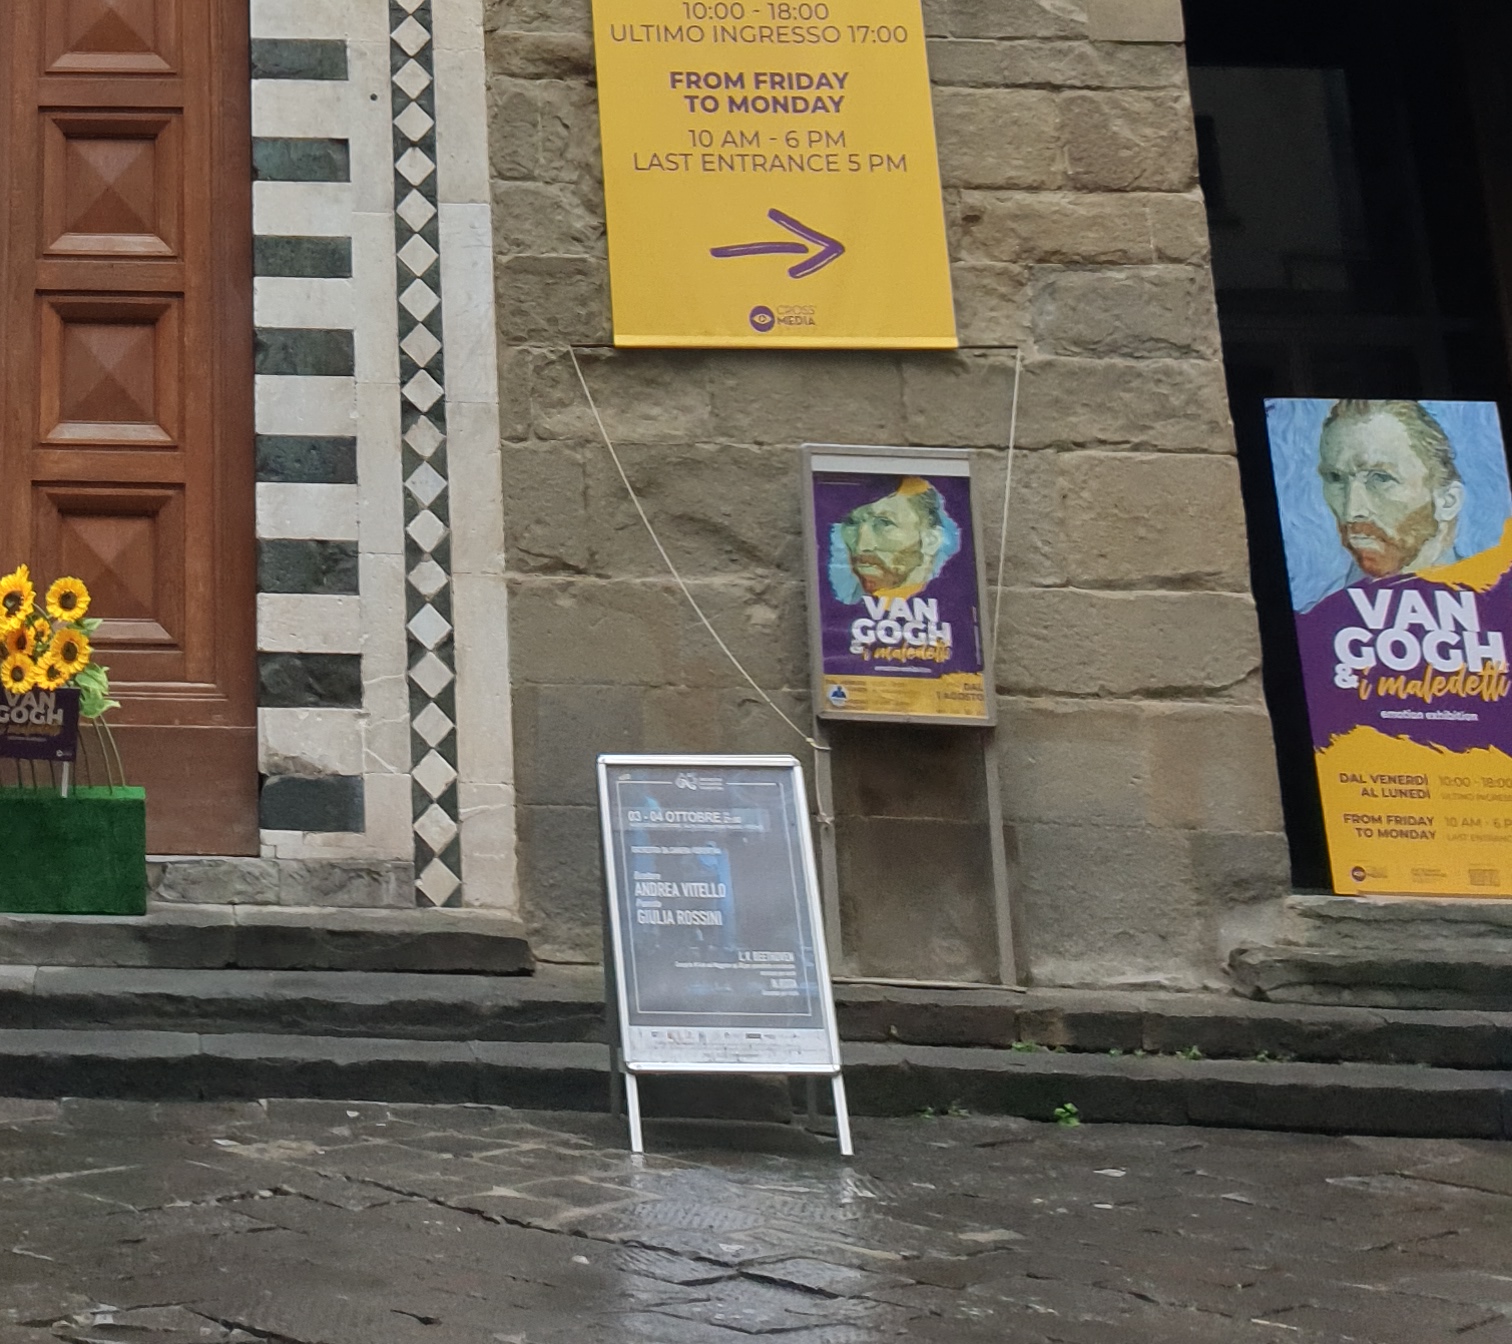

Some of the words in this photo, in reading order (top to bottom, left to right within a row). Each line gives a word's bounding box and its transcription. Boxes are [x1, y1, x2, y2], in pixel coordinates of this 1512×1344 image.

[683, 1, 744, 20] 10:00
[767, 2, 830, 21] 18:00
[610, 23, 705, 43] ULTIMO
[713, 24, 840, 44] INGRESSO
[847, 25, 908, 44] 17:00
[669, 71, 746, 90] FROM
[754, 72, 849, 91] FRIDAY
[684, 95, 719, 113] TO
[728, 95, 845, 113] MONDAY
[688, 129, 714, 148] 10
[720, 130, 760, 148] AM
[784, 130, 800, 149] 6
[807, 130, 846, 148] PM
[633, 152, 693, 171] LAST
[701, 153, 841, 172] ENTRANCE
[847, 154, 862, 172] 5
[868, 154, 907, 172] PM
[776, 315, 816, 325] MEDIA
[862, 595, 939, 622] VAN
[1347, 588, 1480, 632] VAN
[851, 618, 953, 647] GOGH
[1334, 626, 1509, 673] GOGH
[1334, 662, 1359, 689] &
[1377, 661, 1511, 704] maledetti
[4, 691, 56, 712] VAN
[1339, 773, 1367, 784] DAL
[1369, 773, 1429, 786] VENERDÌ
[1439, 776, 1471, 788] 10:00
[1361, 787, 1379, 798] AL
[1382, 788, 1431, 799] LUNEDÌ
[627, 811, 642, 822] 03
[665, 811, 721, 823] OTTOBRE
[1343, 813, 1382, 824] FROM
[1386, 815, 1435, 827] FRIDAY
[1355, 827, 1374, 838] TO
[1377, 828, 1436, 840] MONDAY
[634, 882, 679, 898] ANDREA
[682, 882, 726, 898] VITELLO
[637, 909, 675, 925] GIULIA
[677, 910, 723, 926] ROSSINI
